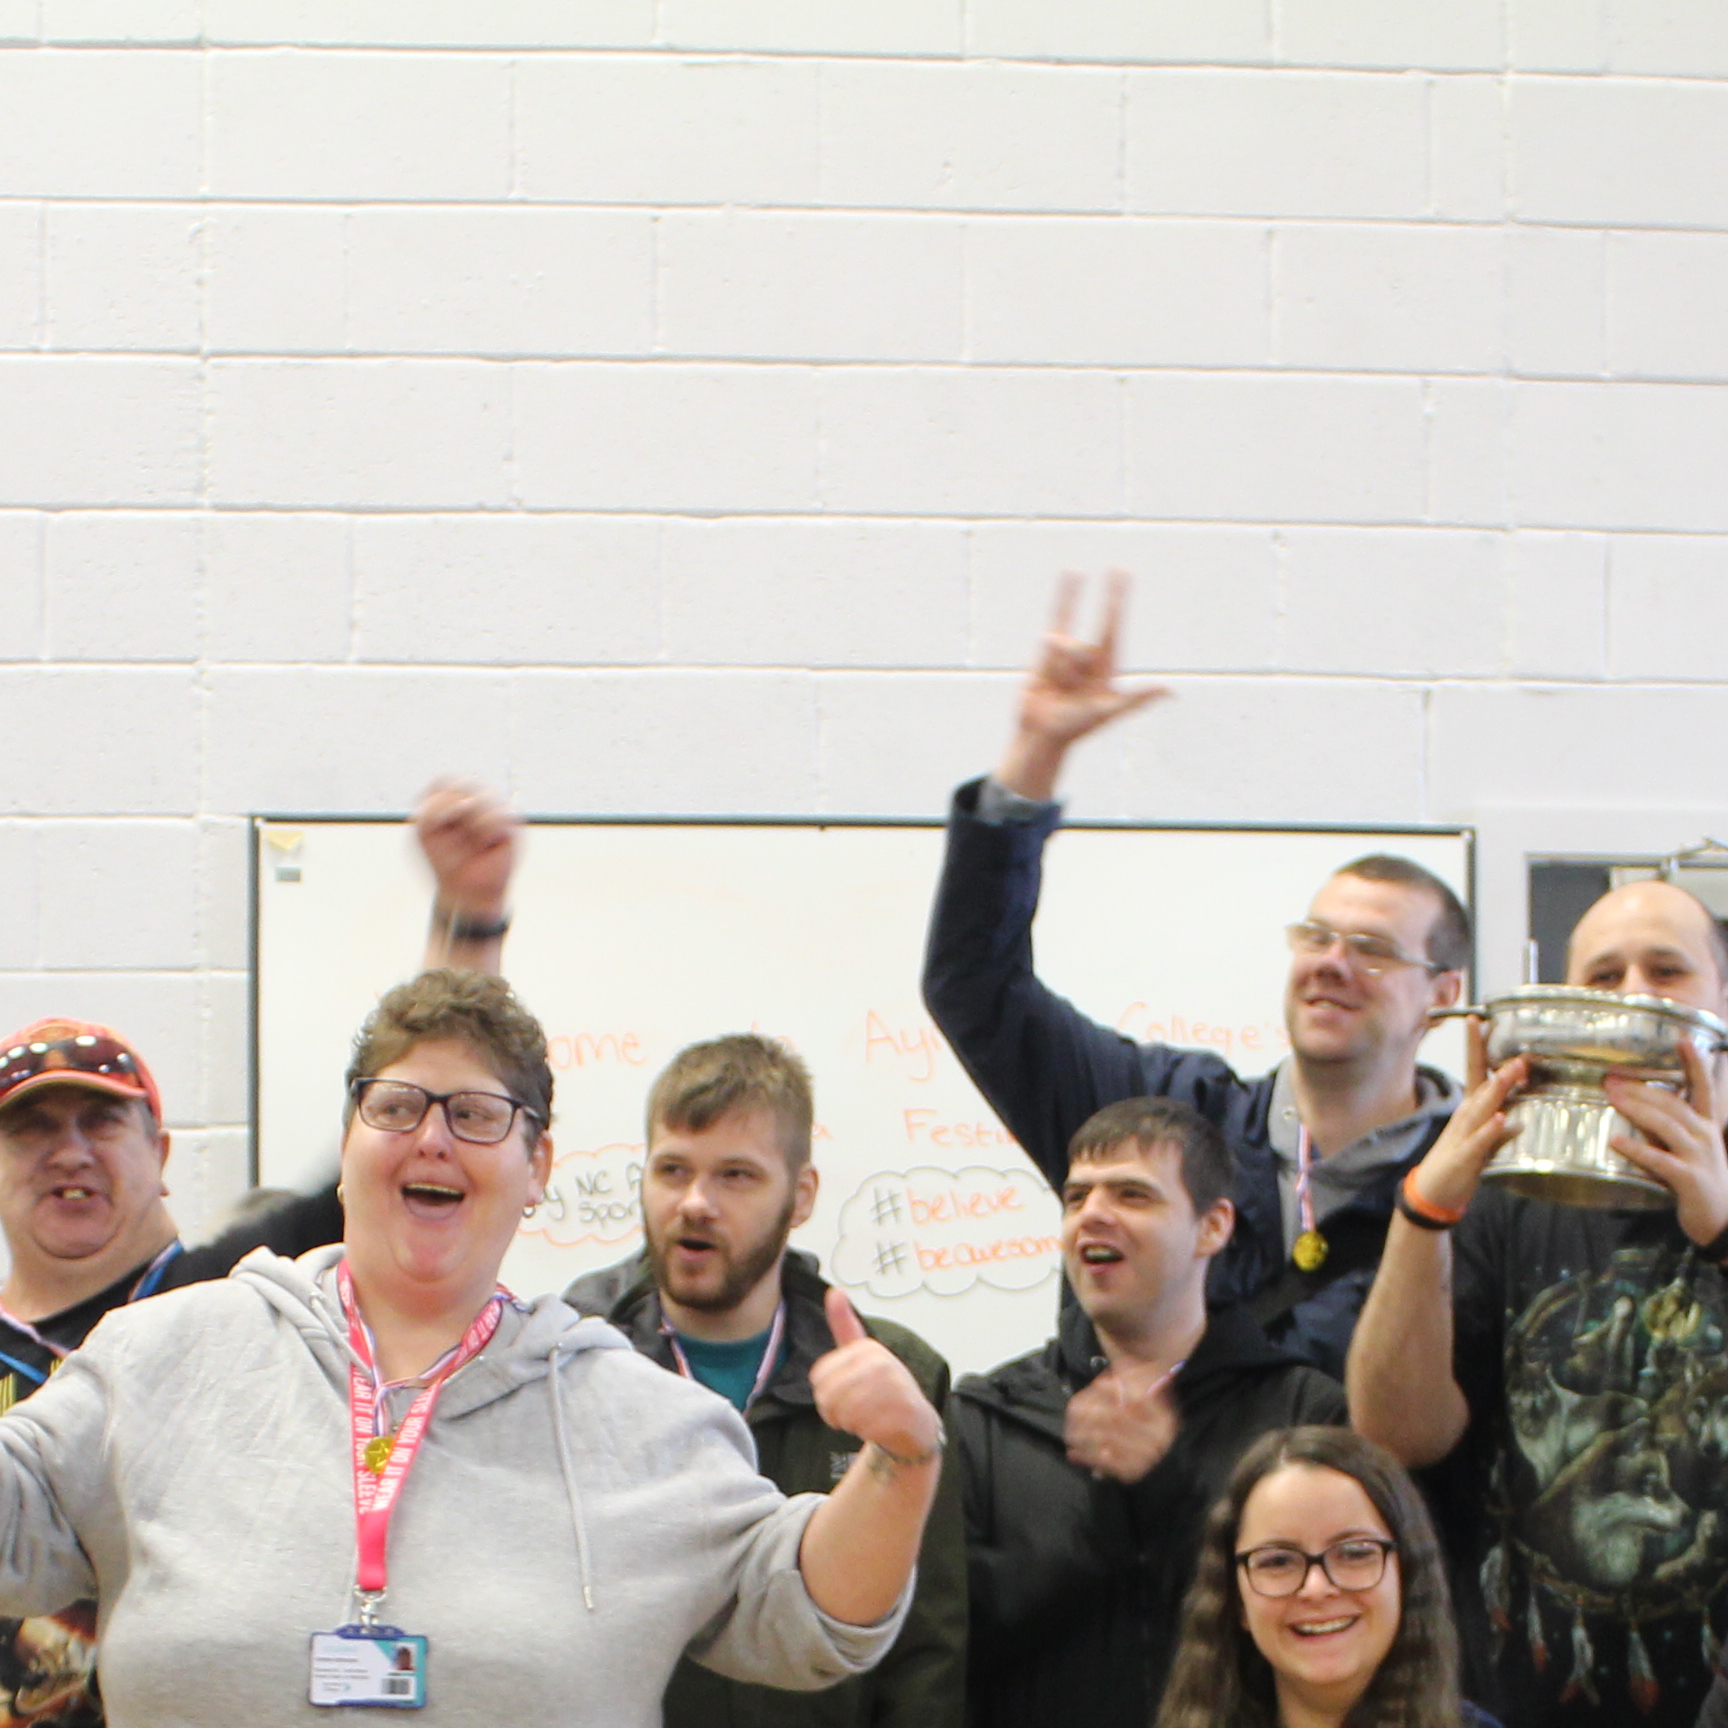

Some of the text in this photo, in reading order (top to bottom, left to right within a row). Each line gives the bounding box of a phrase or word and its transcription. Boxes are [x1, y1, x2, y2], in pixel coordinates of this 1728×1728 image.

[870, 1186, 1026, 1226] #believe
[872, 1235, 1065, 1275] #beawesom
[355, 1416, 373, 1434] ON
[396, 1416, 425, 1445] YOUR
[389, 1446, 412, 1463] ON
[383, 1466, 405, 1477] IT
[373, 1479, 399, 1511] WEAR
